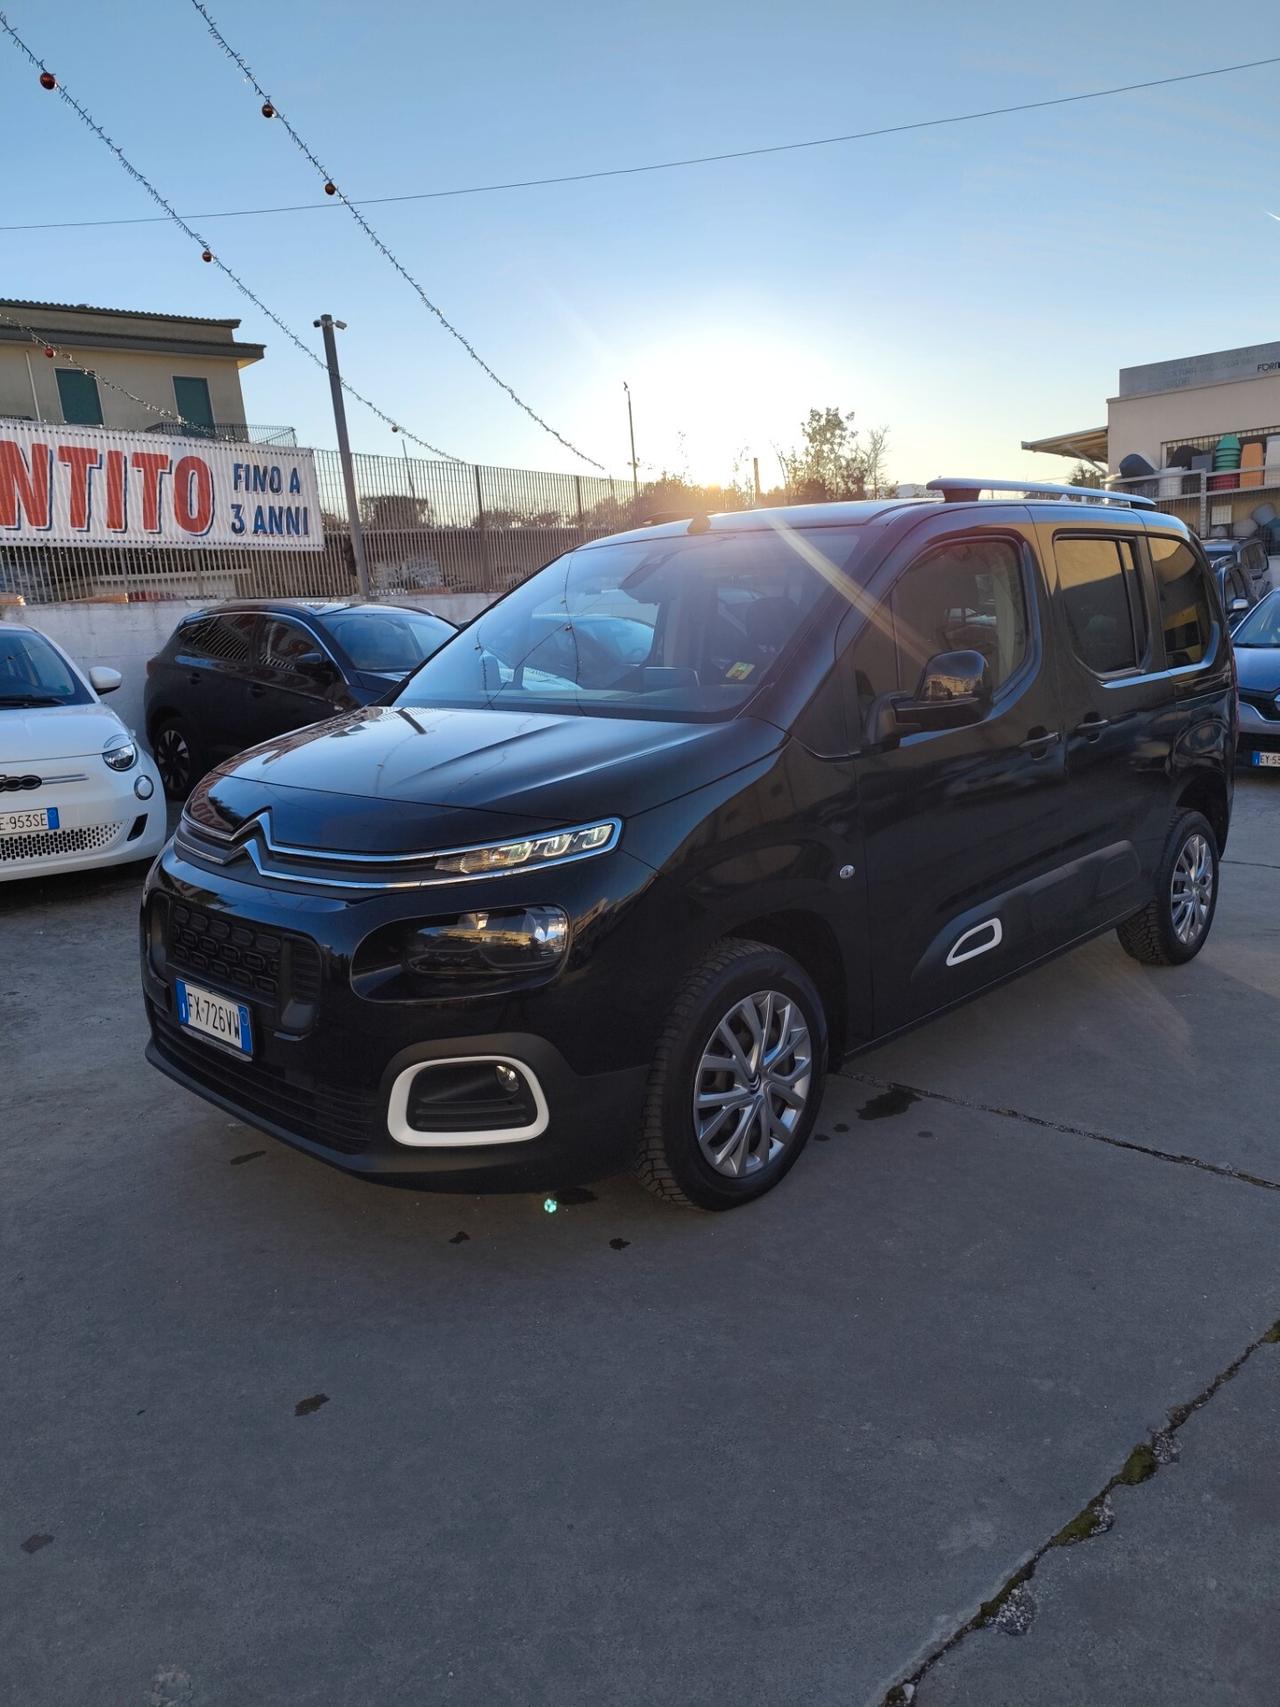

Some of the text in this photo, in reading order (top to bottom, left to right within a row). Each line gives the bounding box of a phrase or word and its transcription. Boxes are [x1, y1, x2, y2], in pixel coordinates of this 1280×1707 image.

[0, 441, 214, 537] NTITO
[233, 463, 303, 496] FINO A
[230, 503, 310, 537] 3 ANNI
